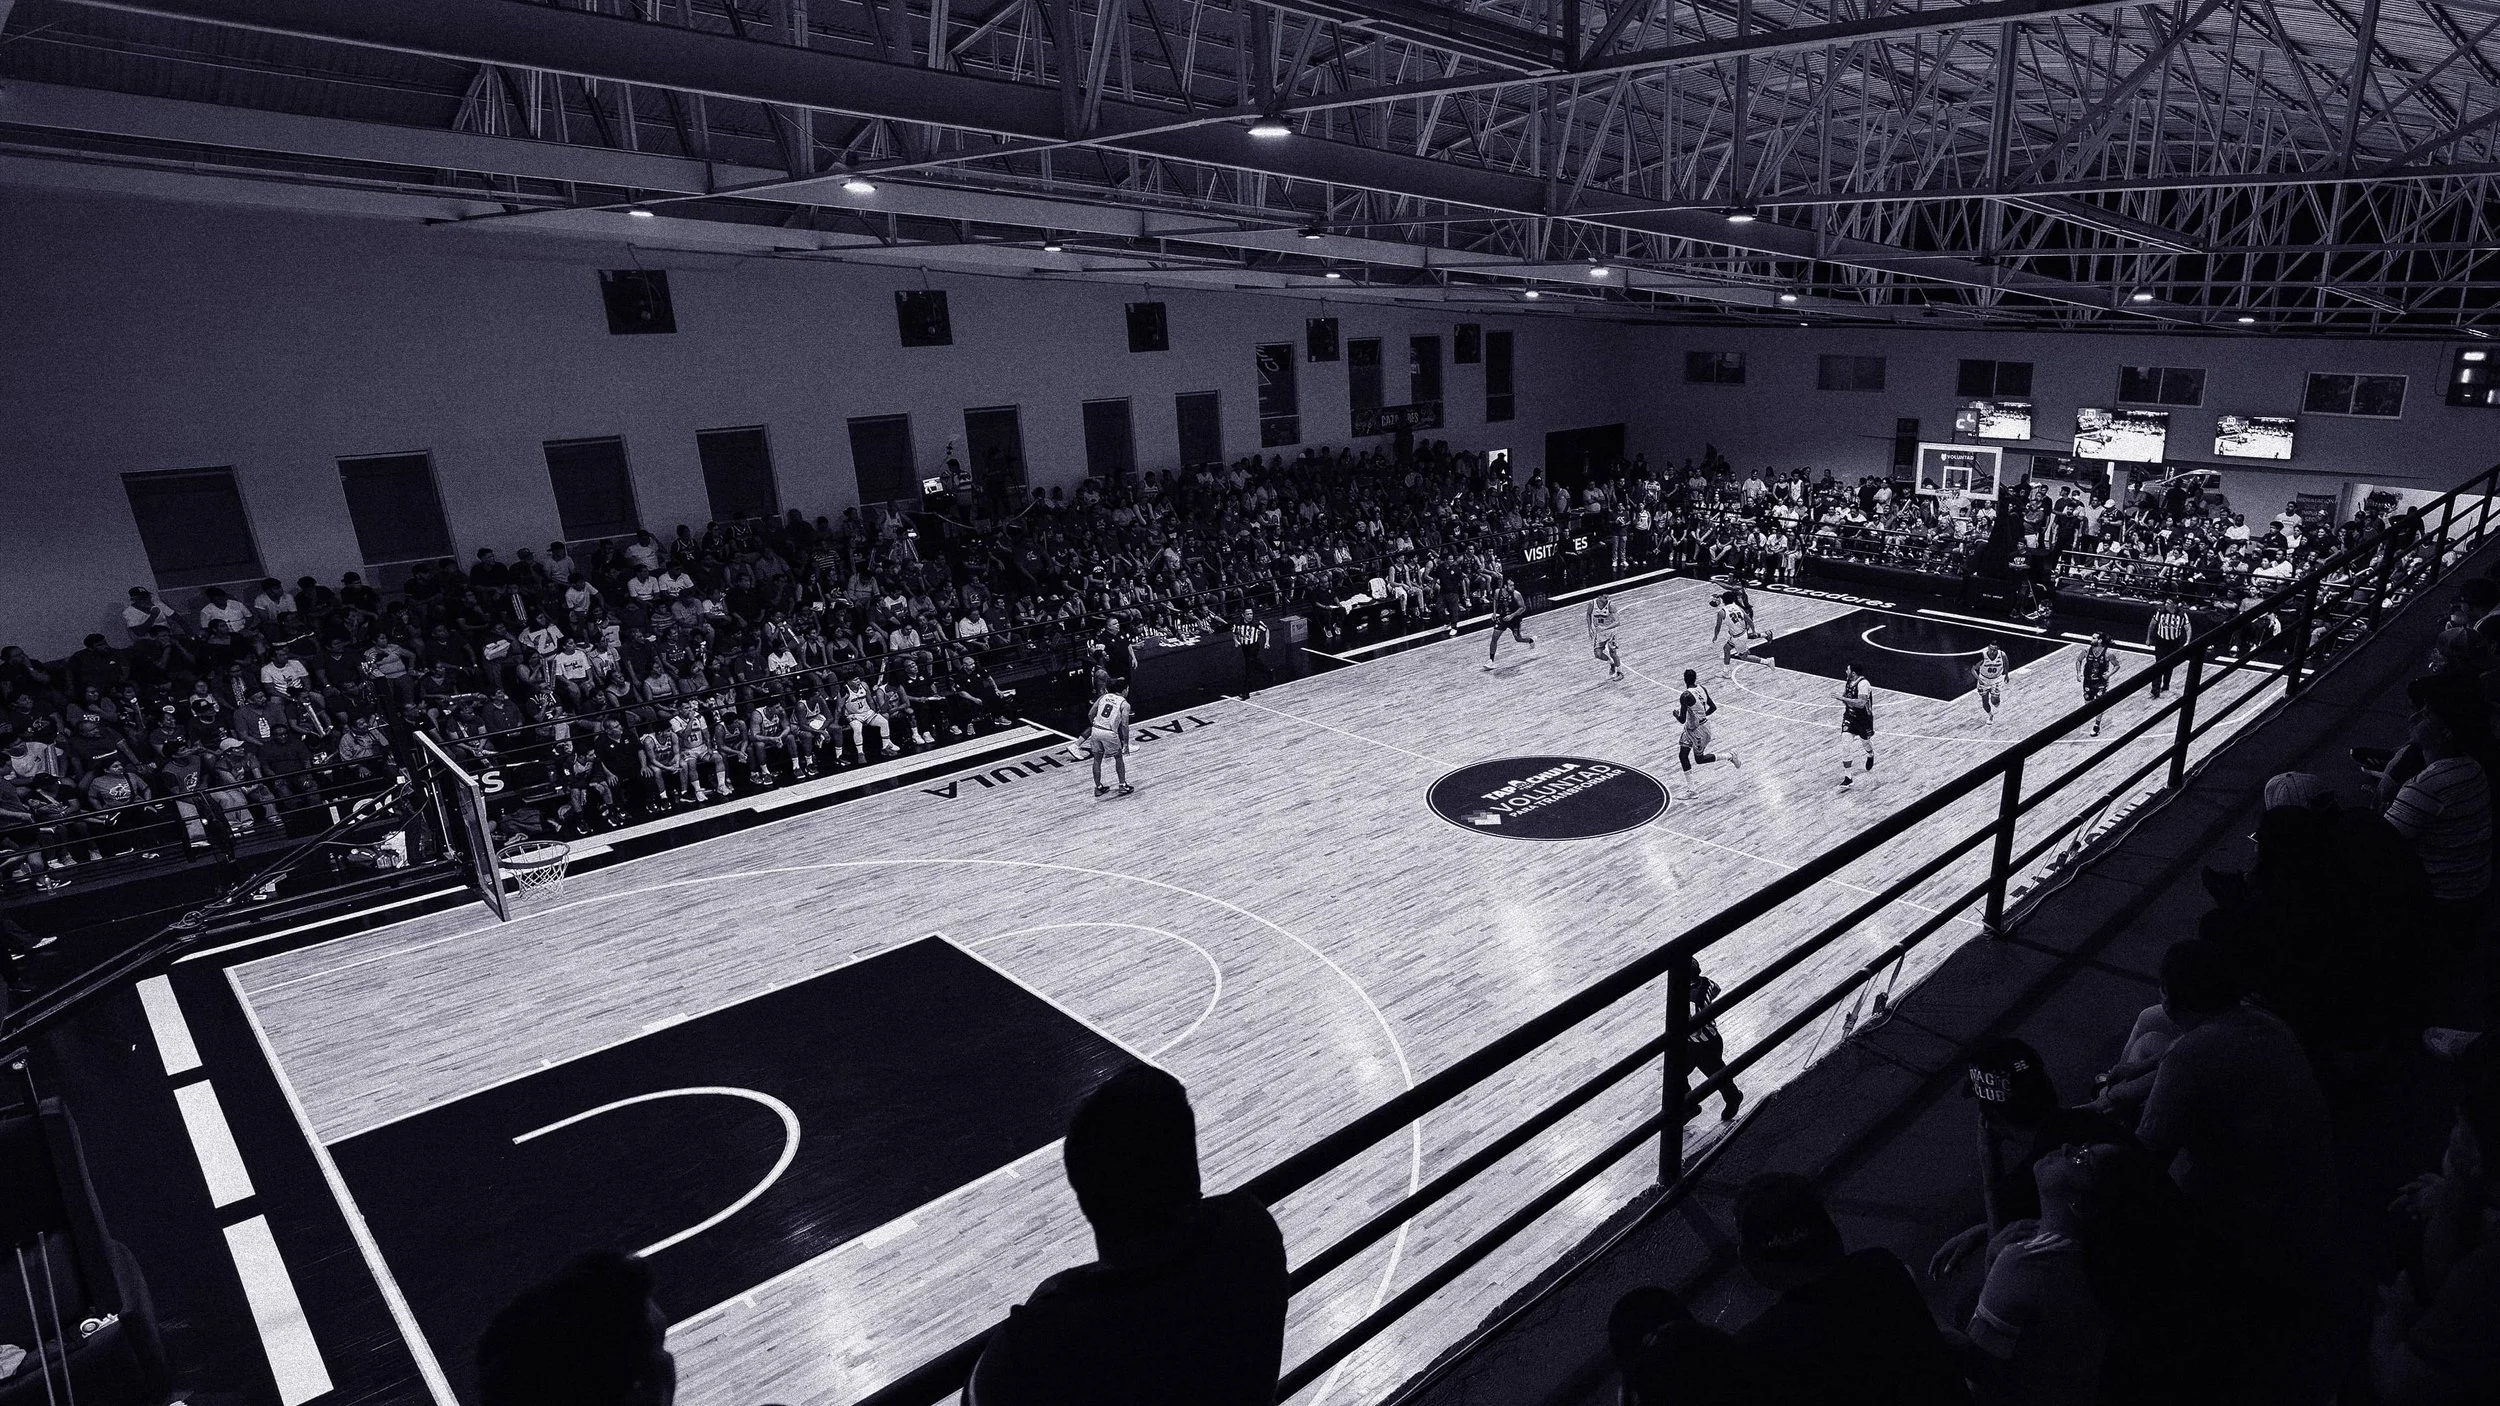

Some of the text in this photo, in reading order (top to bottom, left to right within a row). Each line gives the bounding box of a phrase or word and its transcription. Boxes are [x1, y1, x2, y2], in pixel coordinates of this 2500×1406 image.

[1381, 412, 1419, 427] CAZARES
[1524, 536, 1588, 562] VISITES
[1710, 574, 1897, 609] Cb Cazadores
[1100, 703, 1114, 719] 8
[1481, 763, 1581, 802] TAPACHULA
[1490, 764, 1612, 813] VOLUNTAD
[1509, 769, 1627, 818] PARA TRANSFORMAR
